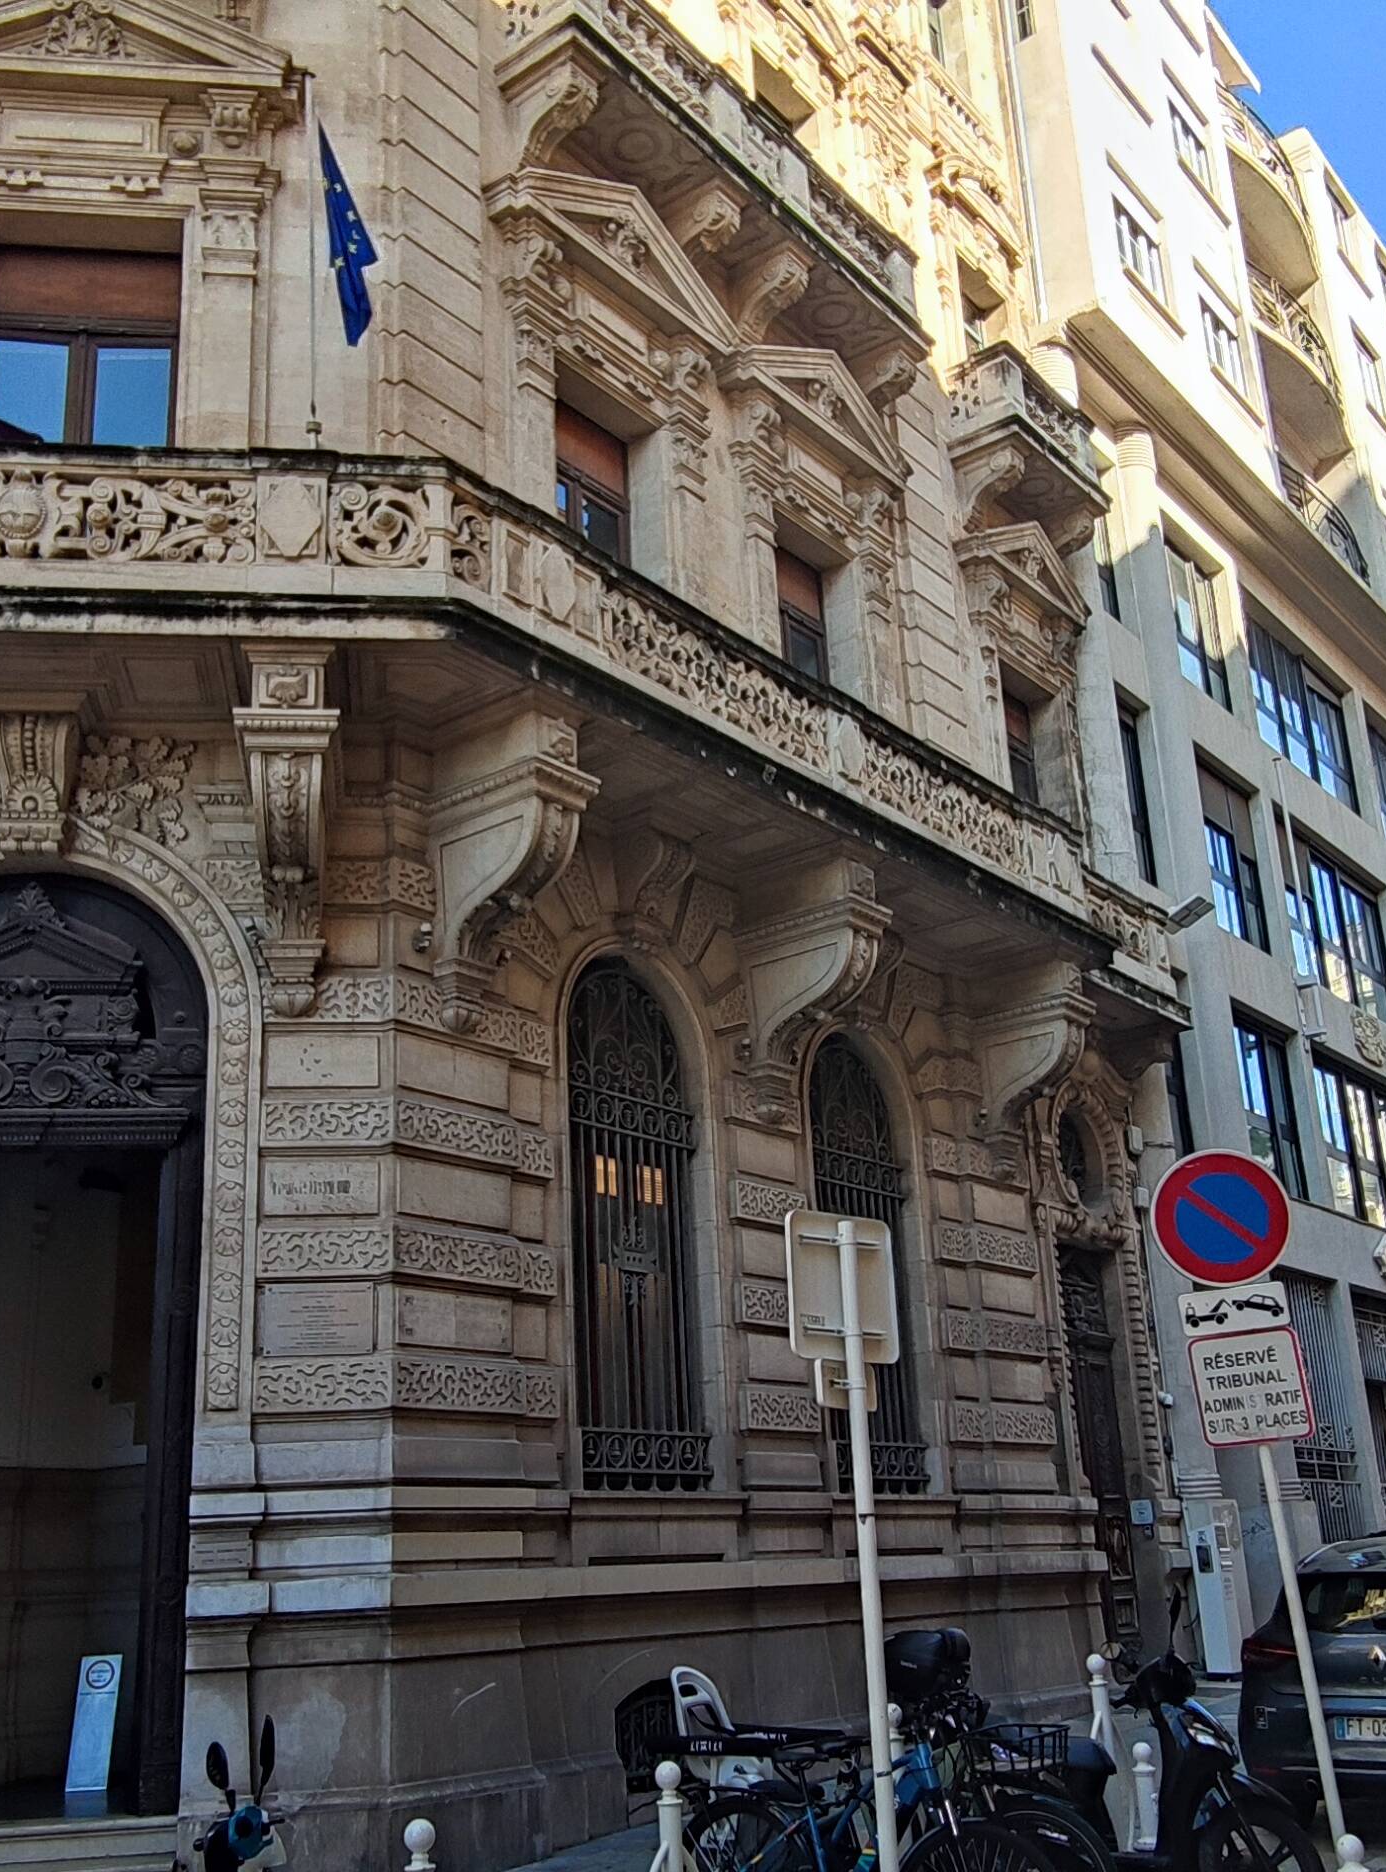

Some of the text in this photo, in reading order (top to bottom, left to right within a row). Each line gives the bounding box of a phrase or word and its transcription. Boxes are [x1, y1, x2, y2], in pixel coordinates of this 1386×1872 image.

[1203, 1346, 1277, 1371] RÉSERVÉ
[1206, 1369, 1287, 1391] TRIBUNAL
[1204, 1389, 1301, 1414] ADMINISRATIF
[1208, 1410, 1308, 1434] SUR 3 PLACES
